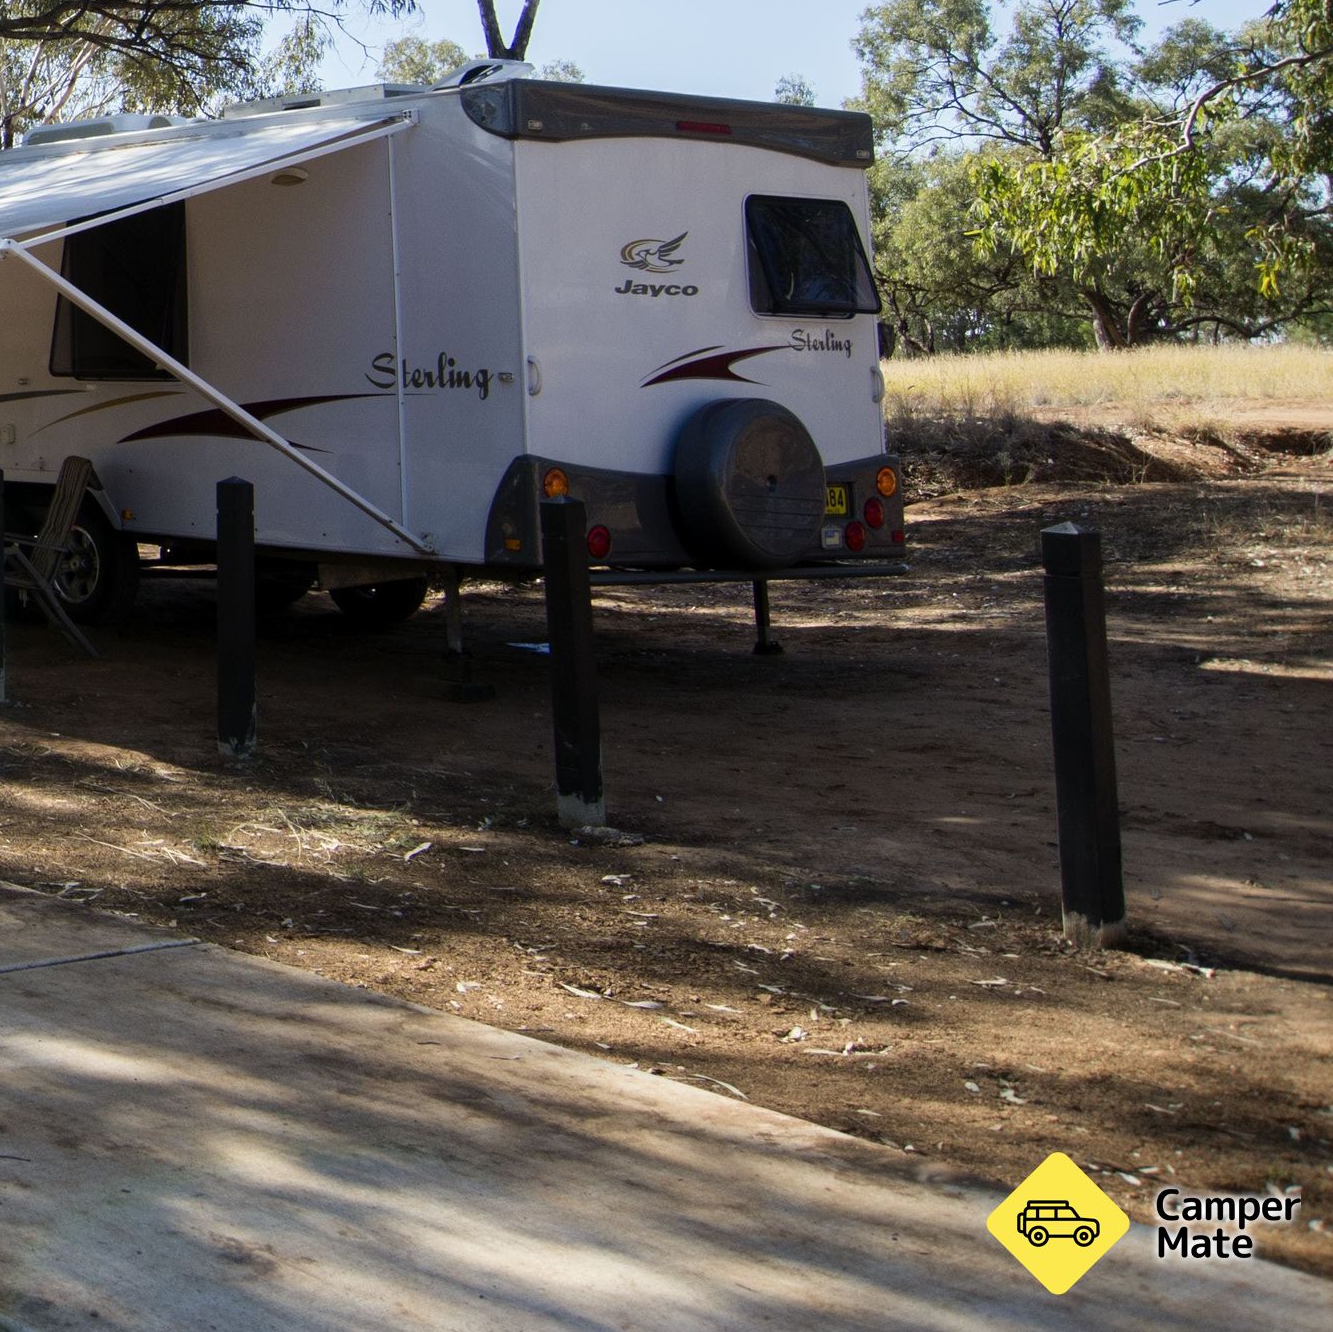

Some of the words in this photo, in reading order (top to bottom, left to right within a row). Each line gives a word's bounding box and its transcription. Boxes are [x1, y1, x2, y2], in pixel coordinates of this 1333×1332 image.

[614, 279, 699, 298] Jayco
[788, 328, 853, 358] Sterling
[364, 351, 494, 400] Sterling
